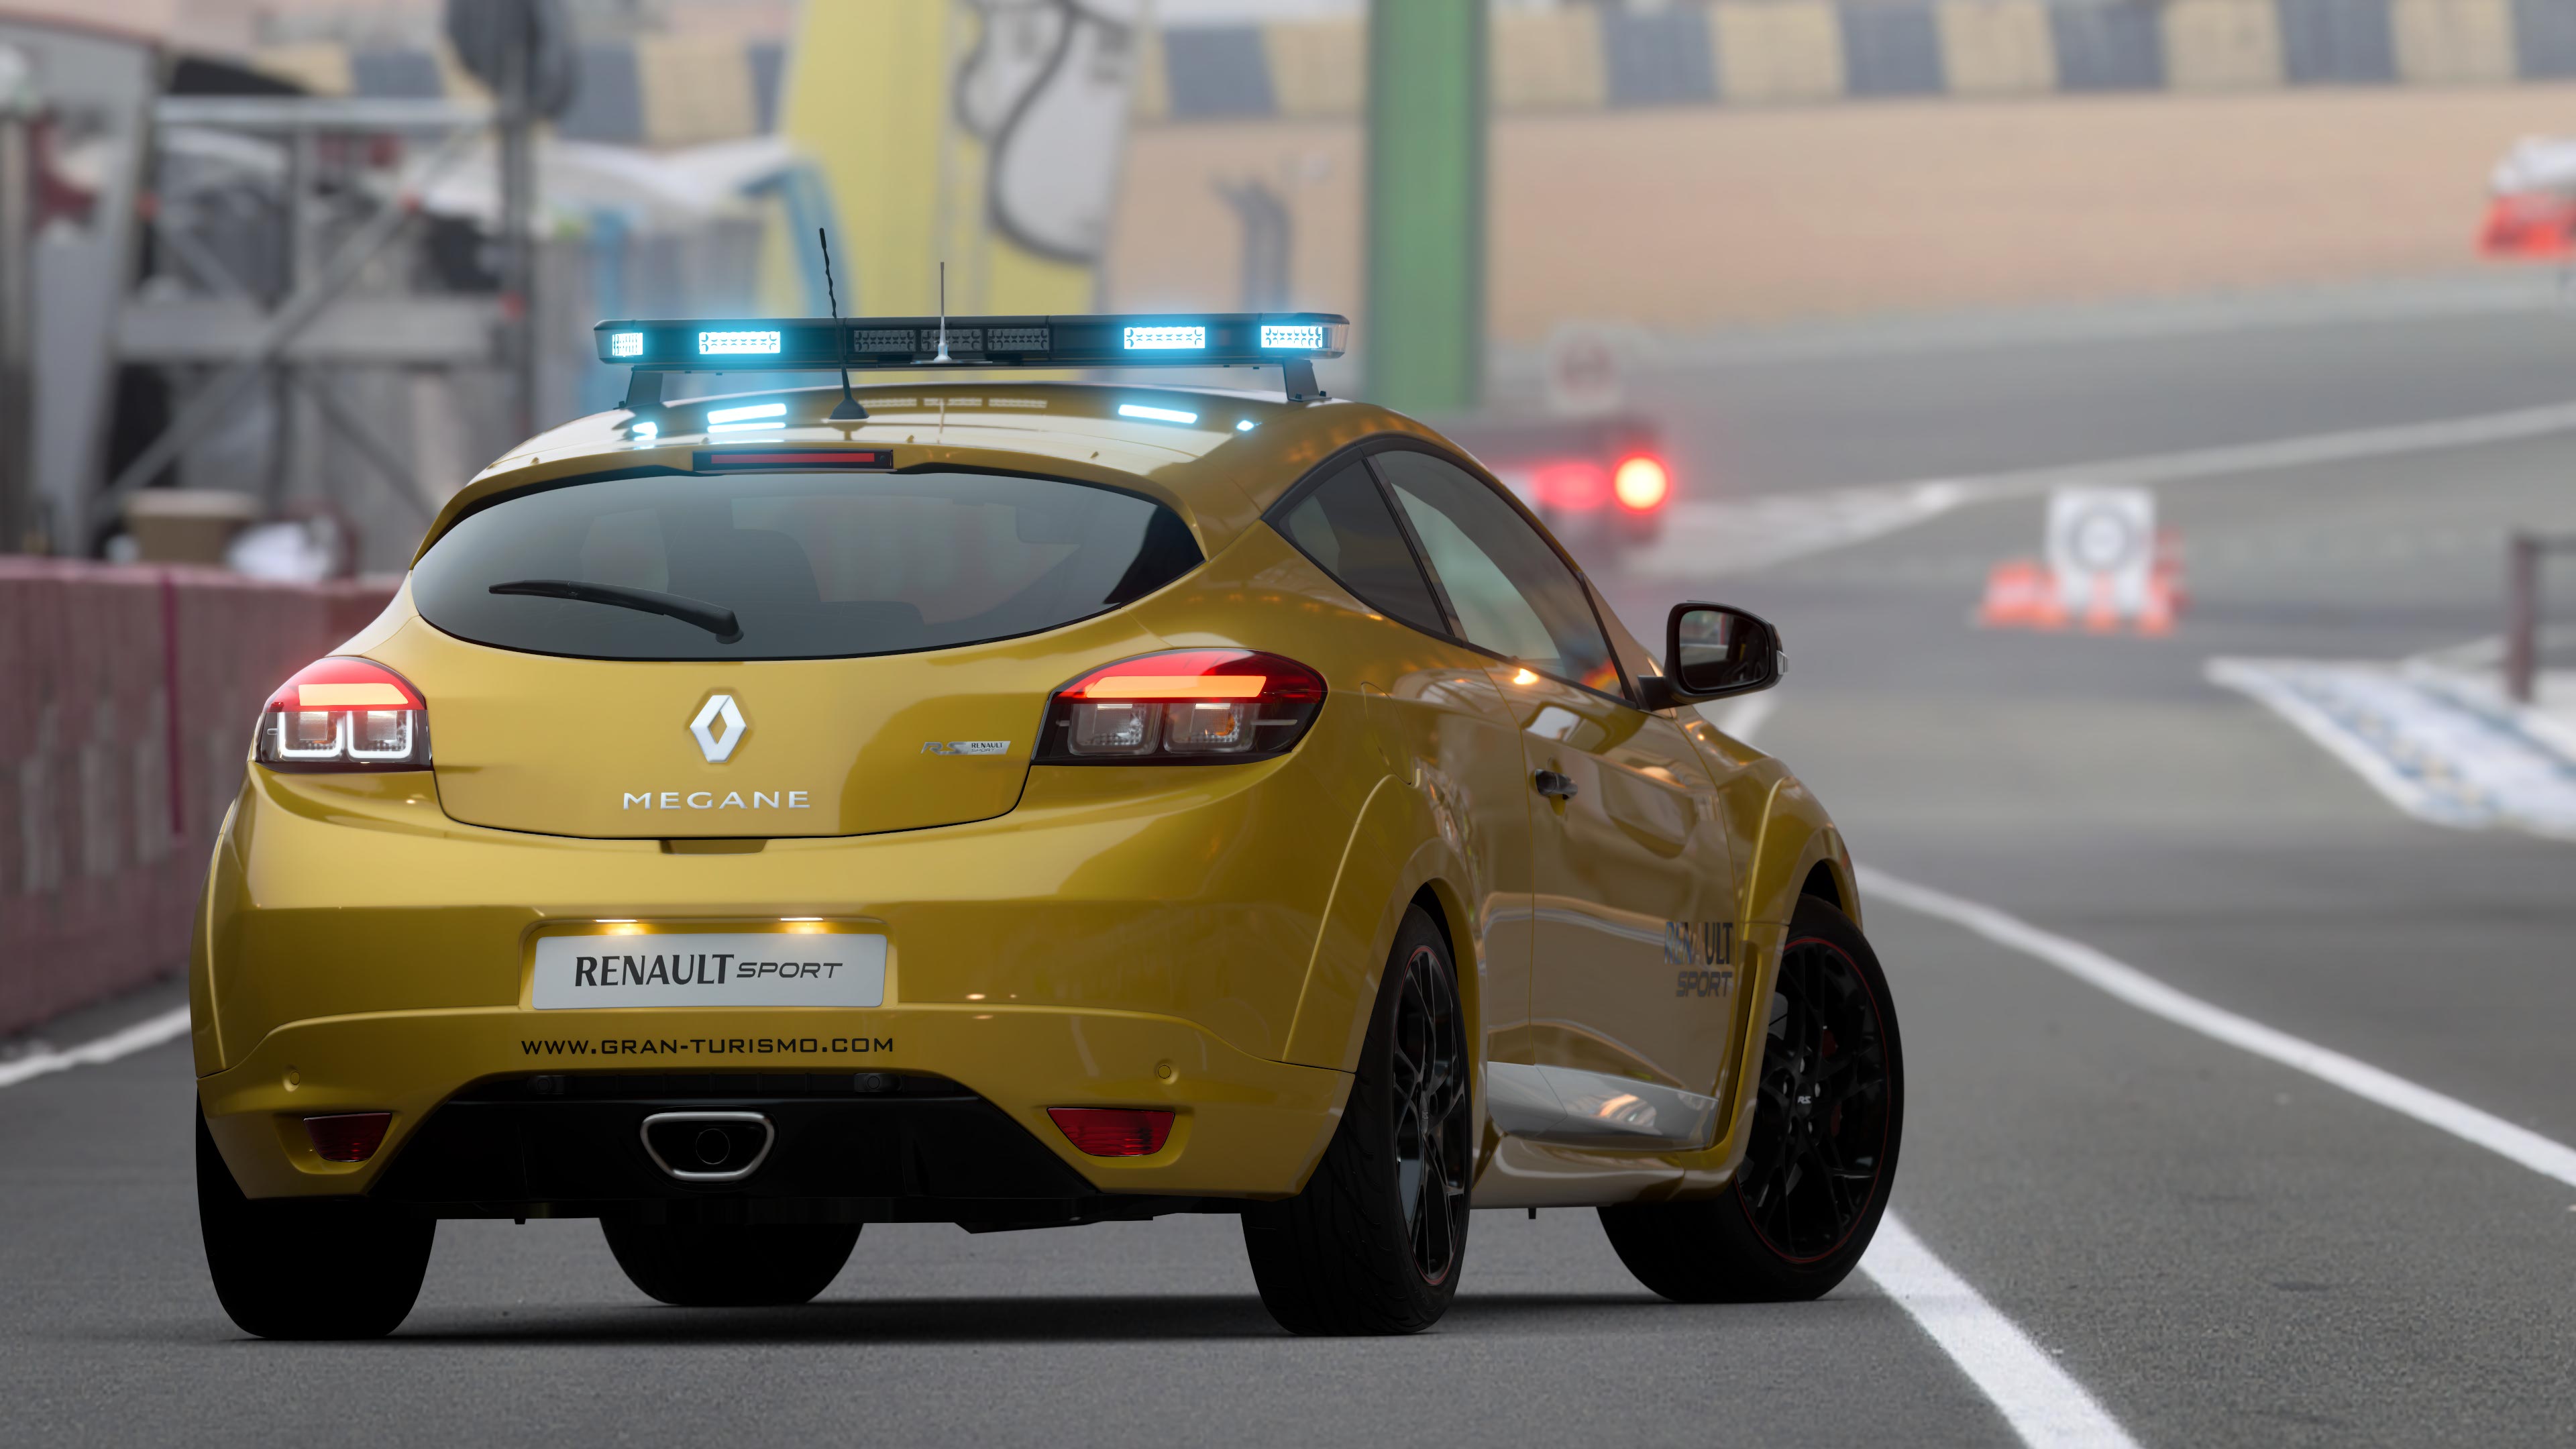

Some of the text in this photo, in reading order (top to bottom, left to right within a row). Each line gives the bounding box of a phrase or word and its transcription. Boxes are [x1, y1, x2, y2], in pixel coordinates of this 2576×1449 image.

[623, 791, 810, 810] MEGANE
[574, 954, 843, 987] RENAULT SPORT
[1676, 971, 1733, 998] SPORT
[521, 1038, 894, 1055] WWW.GRAN-TURISMO.COM
[1797, 1095, 1811, 1104] RS
